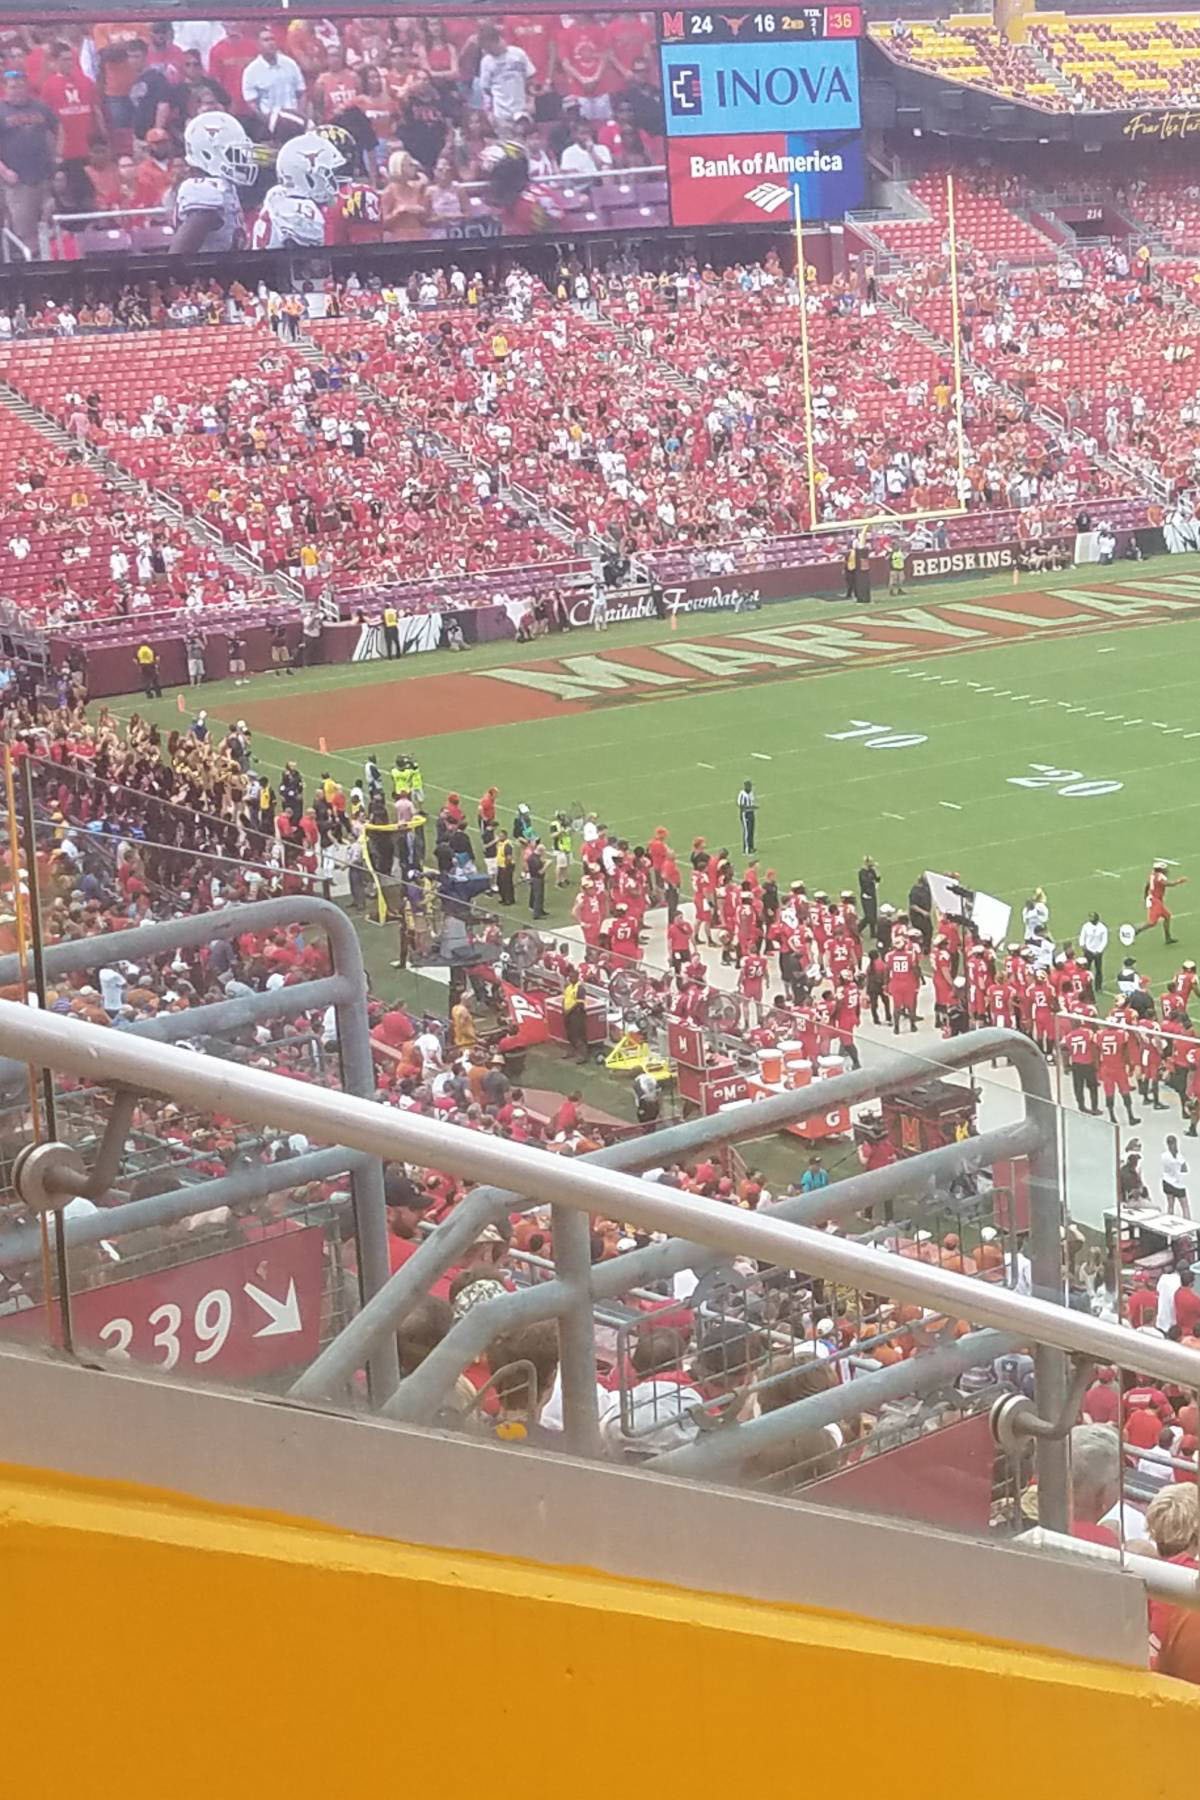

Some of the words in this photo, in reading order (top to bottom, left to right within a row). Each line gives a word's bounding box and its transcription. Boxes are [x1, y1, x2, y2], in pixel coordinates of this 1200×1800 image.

[690, 16, 713, 34] 24
[754, 14, 775, 33] 16
[715, 66, 853, 108] INOVA
[690, 155, 742, 178] Bank
[742, 152, 763, 174] of
[764, 150, 843, 173] America
[893, 961, 909, 973] 88
